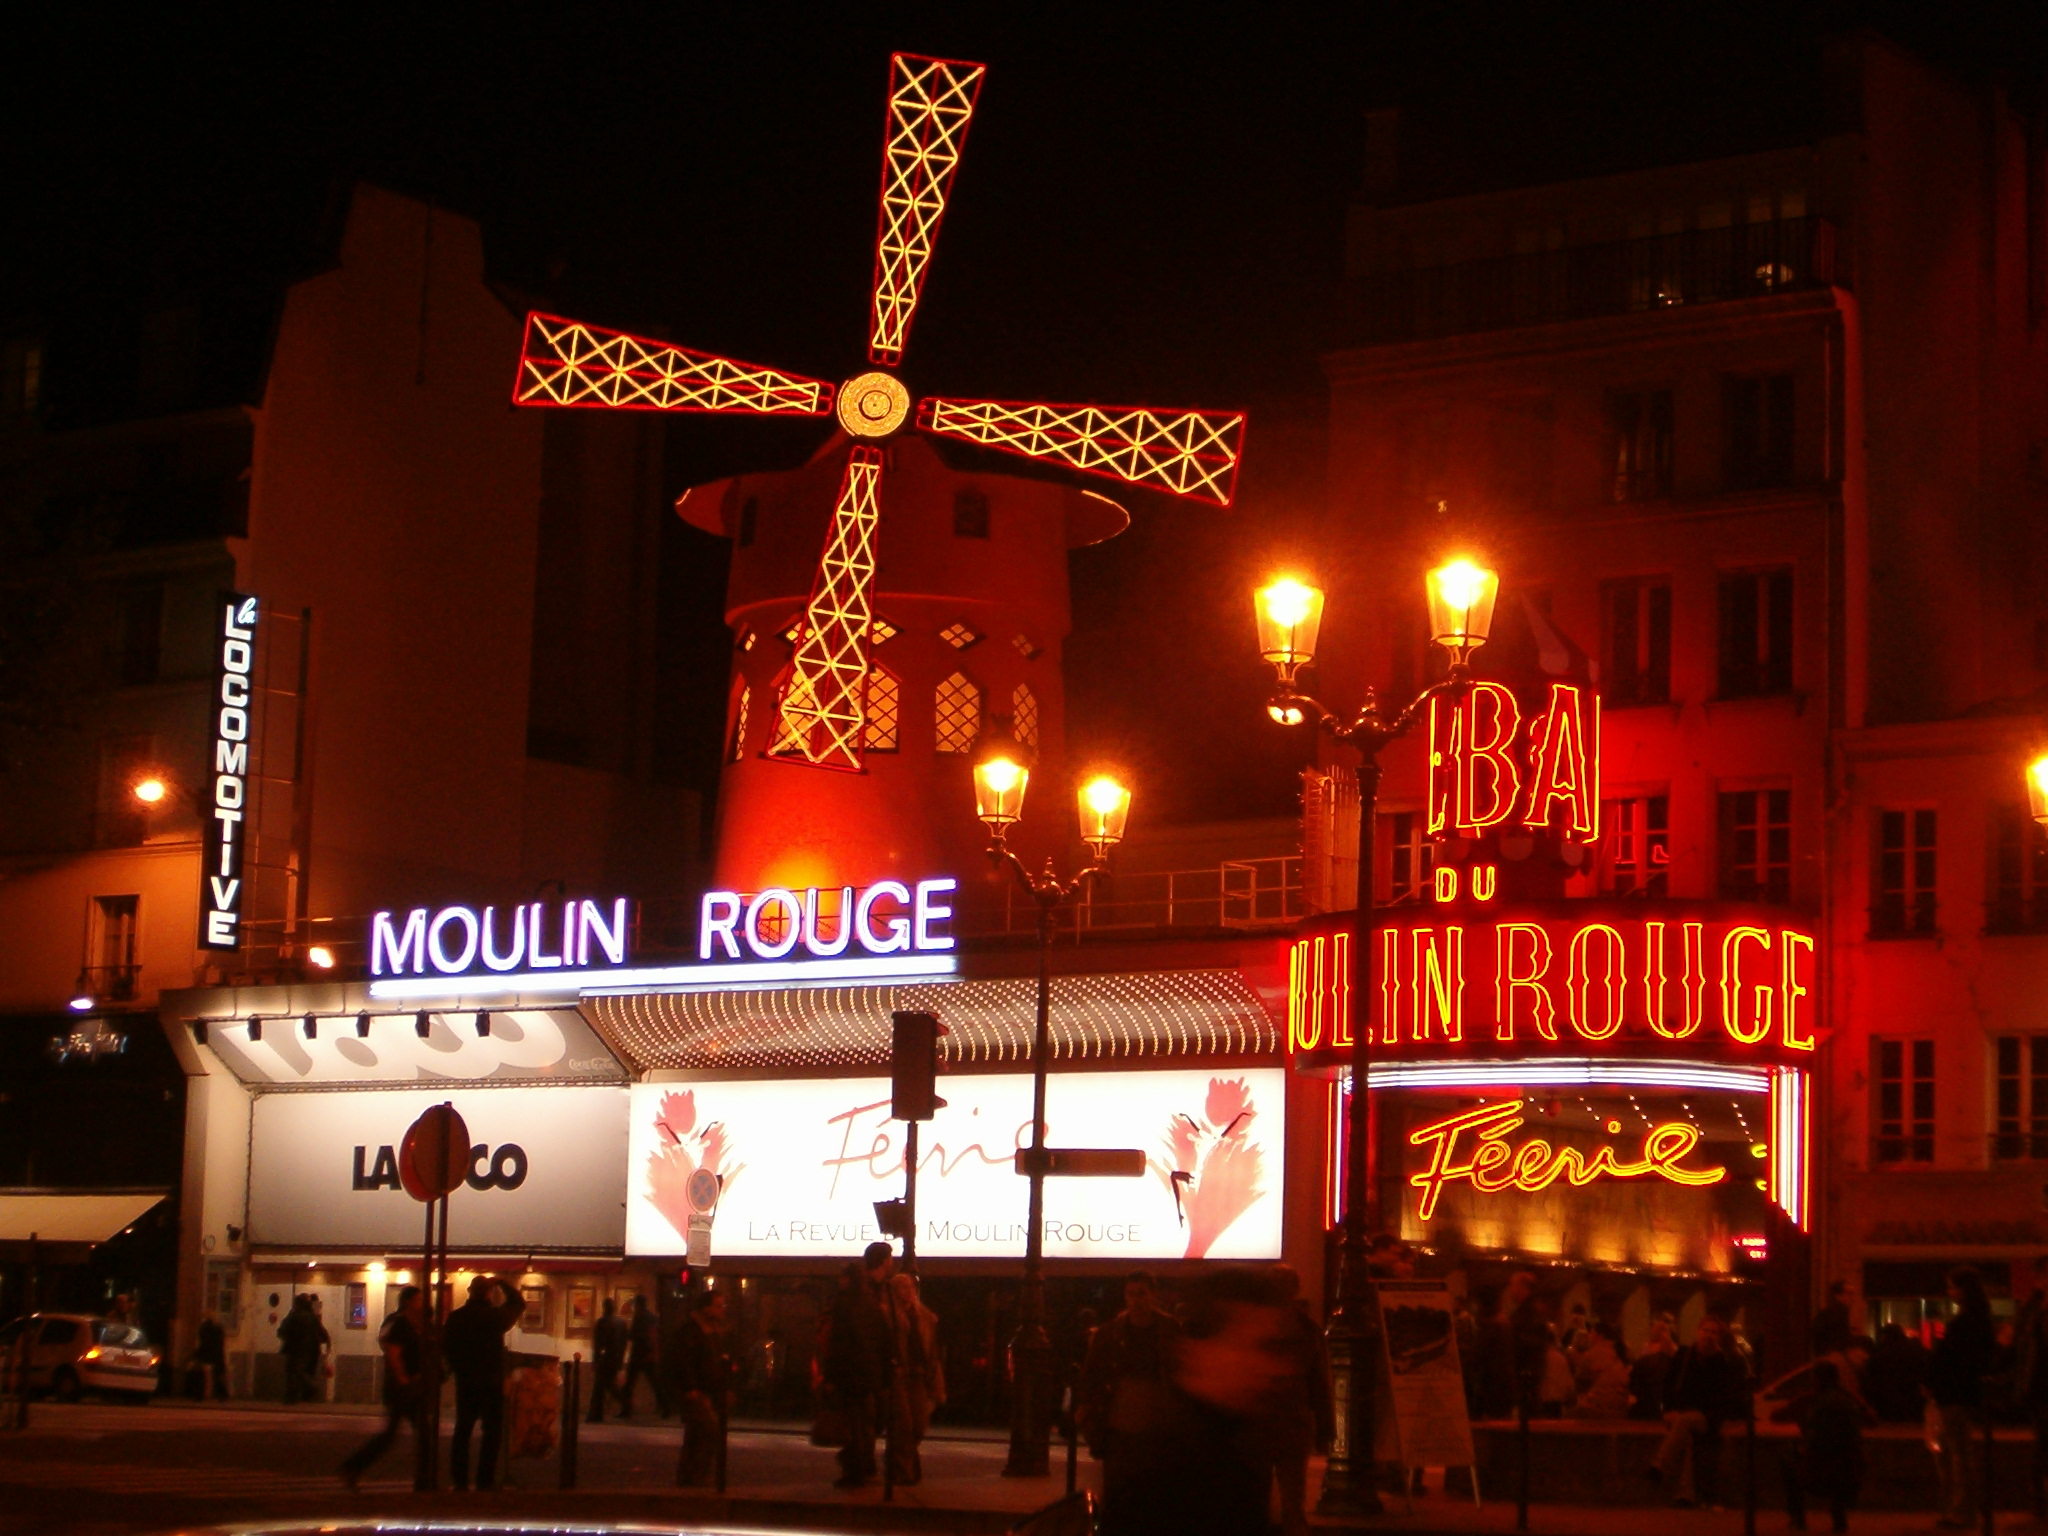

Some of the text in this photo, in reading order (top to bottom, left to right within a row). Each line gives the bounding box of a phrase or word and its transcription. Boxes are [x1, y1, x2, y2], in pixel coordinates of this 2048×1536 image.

[208, 604, 252, 946] LOCOMOTIVE
[370, 878, 957, 976] MOULIN ROUGE
[1435, 865, 1496, 903] DU
[1288, 921, 1816, 1055] ULIN ROUGE
[352, 1143, 528, 1192] LA CO
[1410, 1099, 1727, 1221] Féerie
[748, 1221, 781, 1242] LA
[789, 1221, 875, 1242] REVUE
[927, 1220, 1030, 1242] MOULIN
[1044, 1220, 1143, 1242] ROUGE
